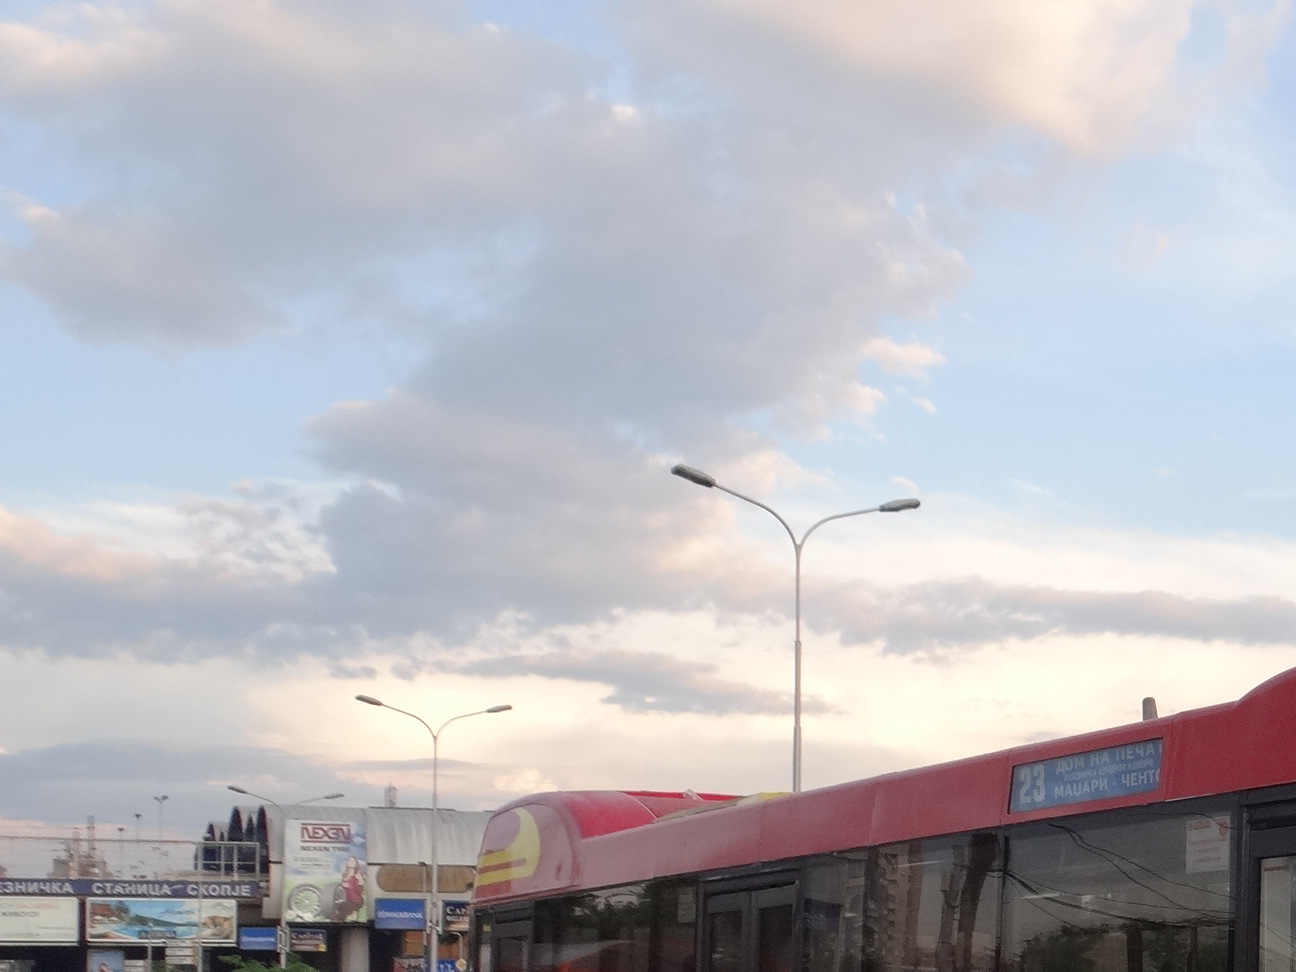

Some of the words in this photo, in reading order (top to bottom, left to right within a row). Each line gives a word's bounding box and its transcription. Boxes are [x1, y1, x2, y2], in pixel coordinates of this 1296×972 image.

[1056, 757, 1085, 775] ДОМ
[1090, 752, 1110, 767] НА
[1019, 764, 1047, 804] 23
[301, 825, 351, 842] NEXEN
[92, 882, 172, 896] СТАНИЦА
[186, 884, 251, 897] СКОПЈЕ
